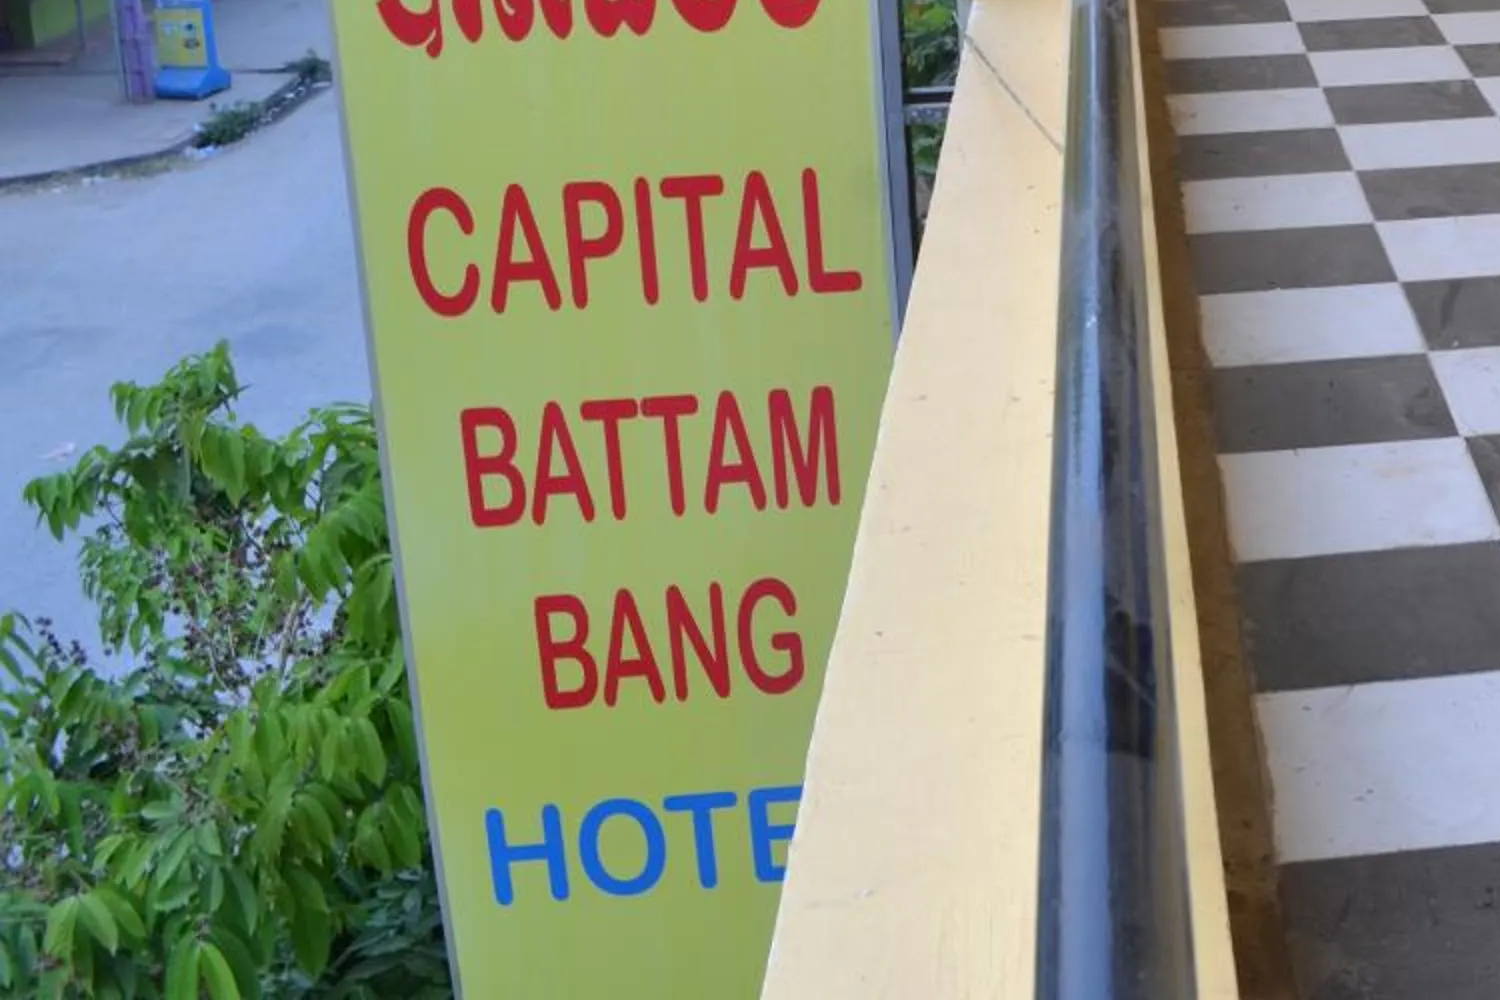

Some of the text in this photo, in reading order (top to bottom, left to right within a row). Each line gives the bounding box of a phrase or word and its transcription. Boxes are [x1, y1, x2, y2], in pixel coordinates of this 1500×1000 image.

[406, 167, 863, 317] CAPITAL
[460, 385, 841, 528] BATTAM
[534, 577, 805, 710] BANG
[485, 785, 806, 906] HOTE
